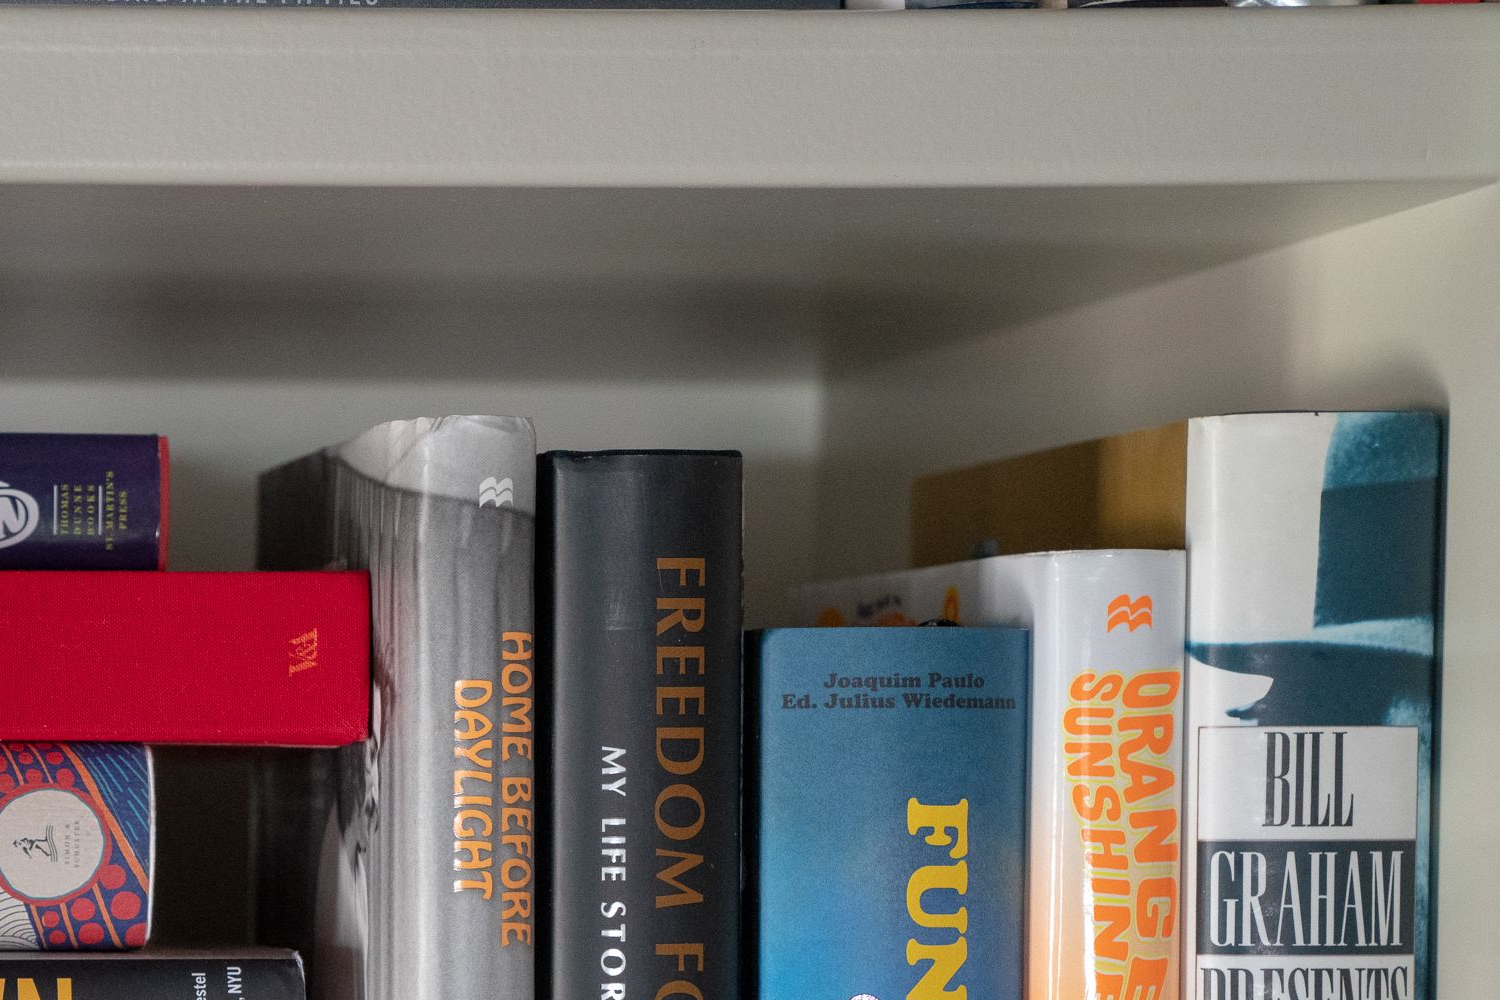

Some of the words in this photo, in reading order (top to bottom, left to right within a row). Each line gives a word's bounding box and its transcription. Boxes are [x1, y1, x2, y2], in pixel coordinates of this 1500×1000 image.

[60, 483, 69, 535] THOMAS
[73, 484, 82, 535] DUNNE
[86, 484, 96, 535] BOOKS
[118, 491, 128, 529] PRESS
[501, 631, 532, 762] HOME
[781, 693, 818, 710] Ed.
[823, 693, 897, 710] Julius
[901, 693, 1017, 710] Wiedemann
[823, 672, 922, 692] Joaquim
[927, 672, 986, 689] Paulo
[653, 557, 706, 910] FREEDOM
[452, 679, 493, 900] DAYLIGHT
[600, 745, 627, 798] MY
[1261, 731, 1354, 828] BILL
[500, 776, 533, 948] BEFORE
[600, 817, 627, 882] LIFE
[1209, 850, 1404, 948] GRAHAM
[226, 966, 243, 994] NYU
